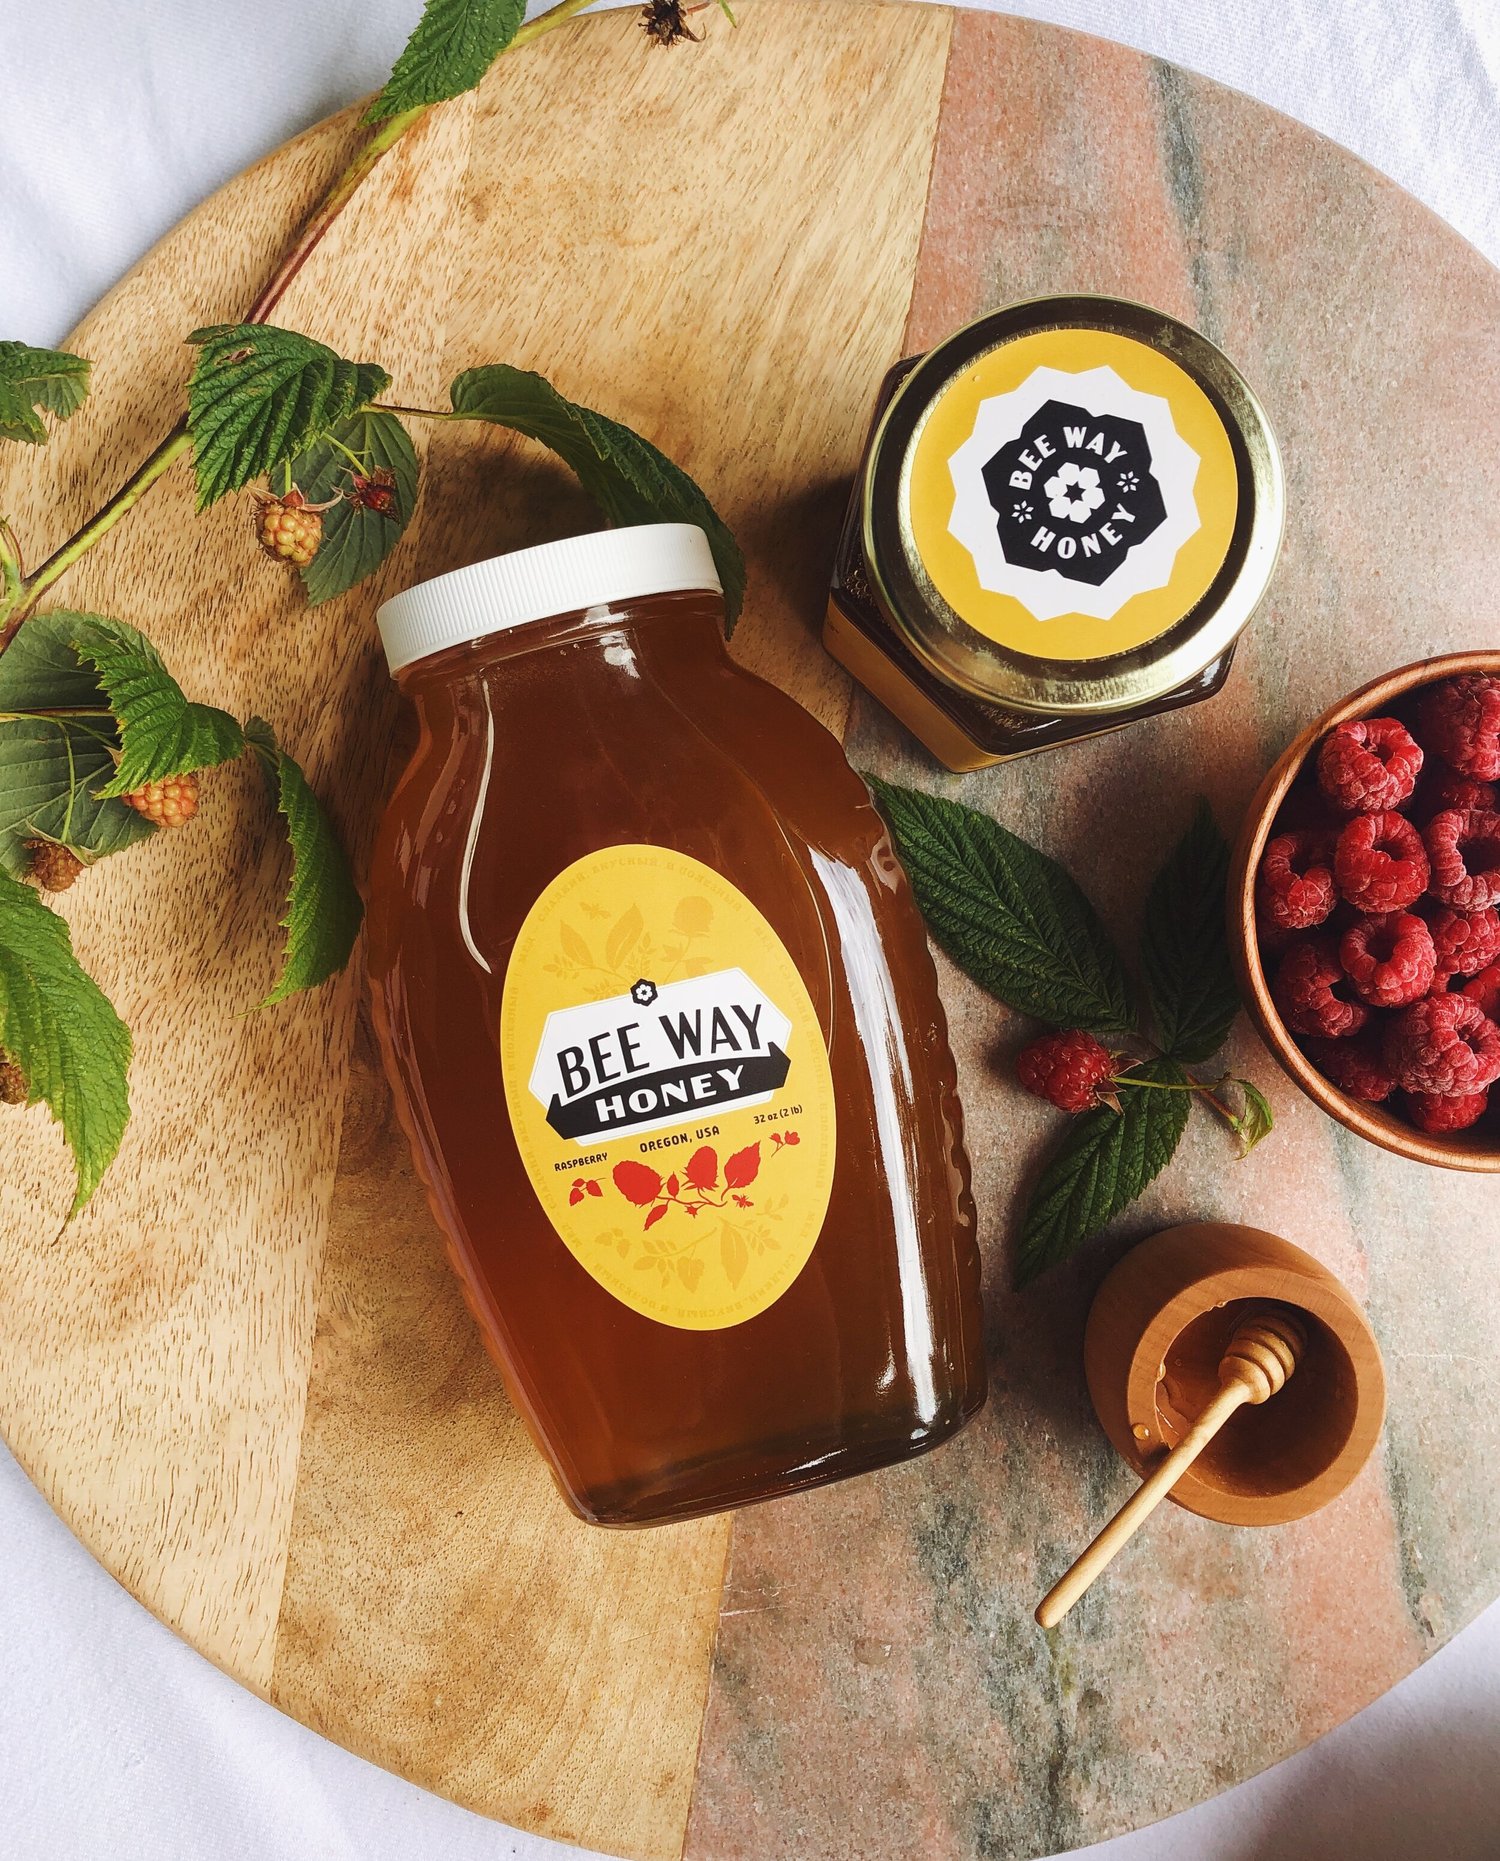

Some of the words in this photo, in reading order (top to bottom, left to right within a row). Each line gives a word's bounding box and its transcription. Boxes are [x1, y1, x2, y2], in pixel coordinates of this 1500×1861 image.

[1008, 434, 1057, 491] BEE
[1063, 426, 1128, 464] WAY
[1030, 502, 1136, 559] HONEY
[557, 1022, 650, 1099] BEE
[658, 1003, 763, 1060] WAY
[595, 1064, 744, 1123] HONEY
[753, 1115, 766, 1124] 32
[767, 1111, 778, 1121] oz
[779, 1108, 789, 1119] (2
[790, 1104, 803, 1115] lb)
[554, 1152, 608, 1172] RASPBERRY
[639, 1133, 693, 1154] OREGON,
[695, 1125, 721, 1143] USA
